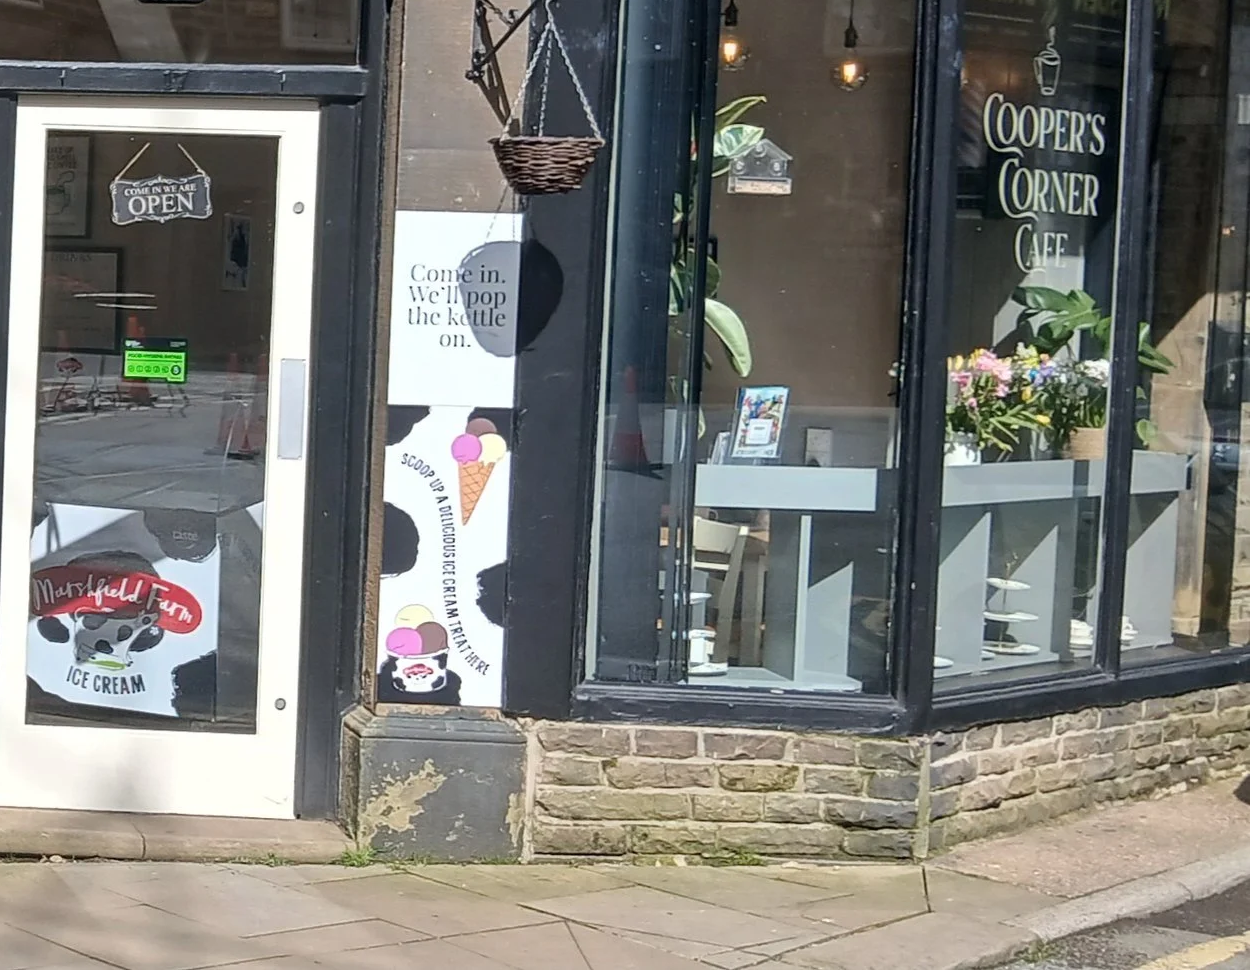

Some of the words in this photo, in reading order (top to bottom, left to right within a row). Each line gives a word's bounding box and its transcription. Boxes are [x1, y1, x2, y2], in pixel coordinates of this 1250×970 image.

[983, 92, 1106, 157] COOPER'S
[124, 187, 151, 196] COME
[152, 185, 162, 194] IN
[163, 184, 178, 193] WE
[179, 183, 197, 191] ARE
[999, 158, 1099, 221] CORNER
[128, 192, 194, 215] OPEN
[1014, 223, 1069, 273] CAFE
[410, 264, 472, 283] Come
[480, 264, 506, 283] in.
[466, 291, 506, 309] pop
[408, 306, 441, 325] the
[447, 306, 506, 327] kettle
[439, 333, 471, 348] on.
[401, 453, 435, 478] SCOOP
[429, 478, 445, 492] UP
[435, 495, 449, 504] A
[438, 505, 456, 558] DELICIOUS
[442, 560, 456, 575] ICE
[32, 574, 143, 611] Marshfield
[146, 581, 193, 624] Farm
[442, 578, 459, 619] CREAM
[448, 620, 472, 653] TREAT
[464, 651, 490, 675] HERE
[66, 665, 90, 690] ICE
[93, 673, 146, 695] CREAM
